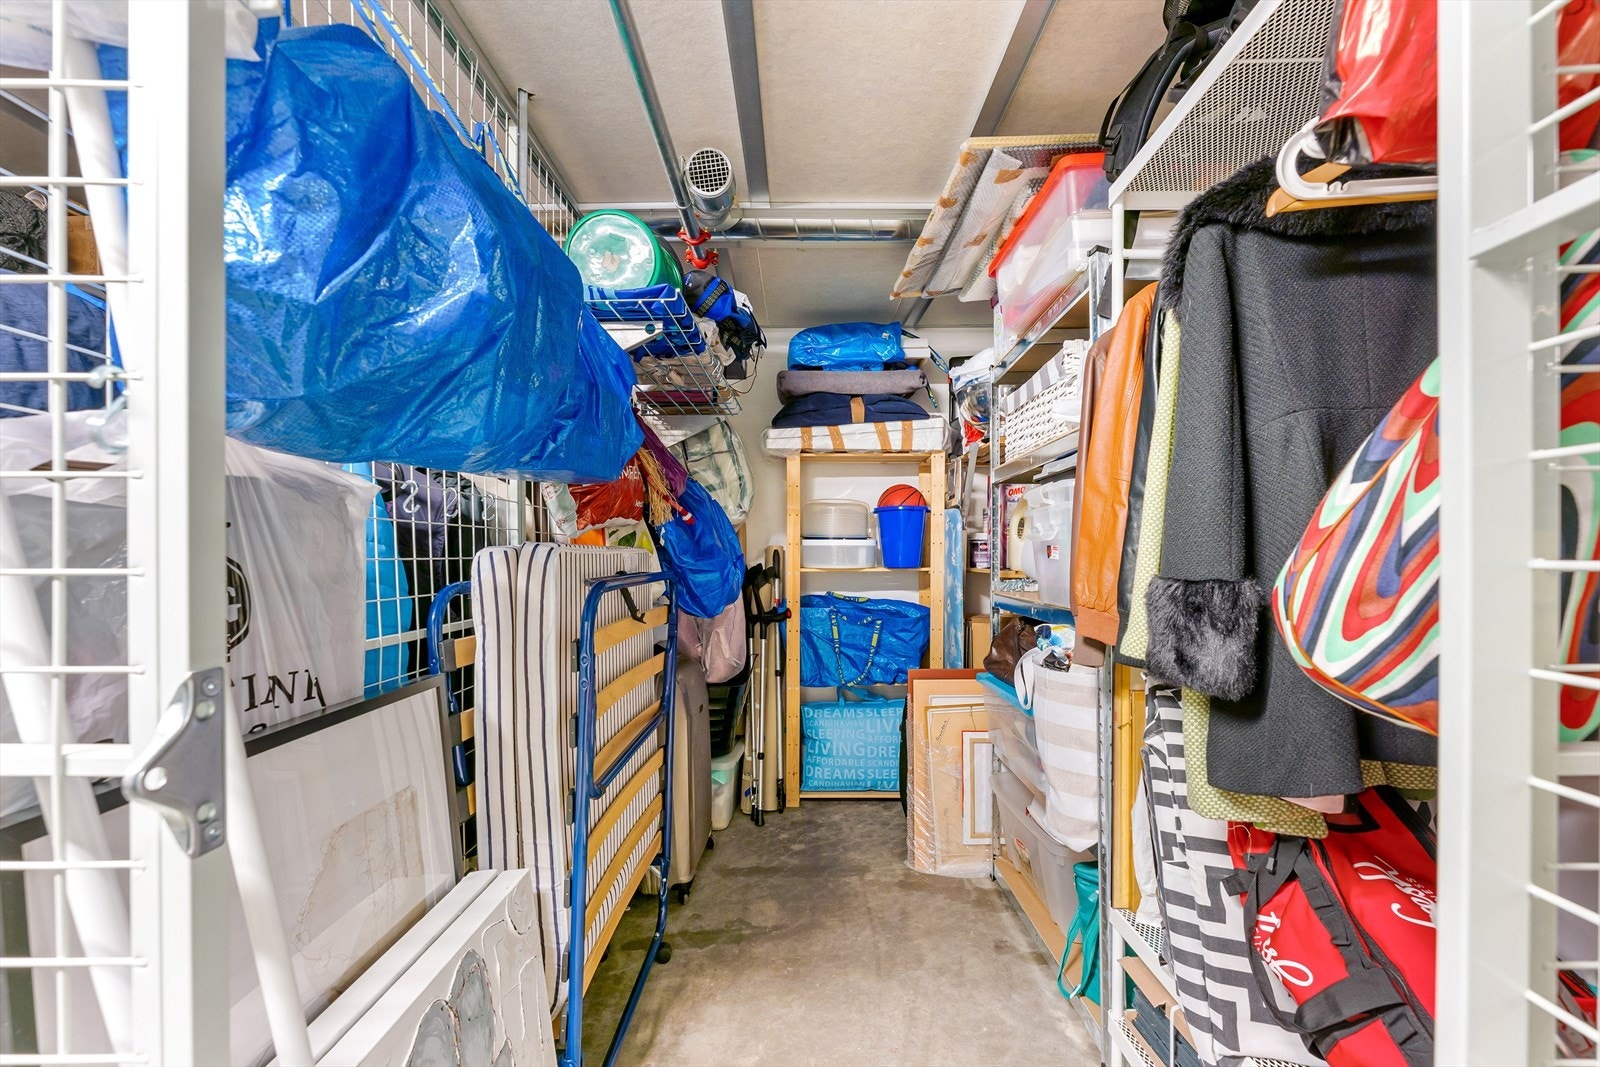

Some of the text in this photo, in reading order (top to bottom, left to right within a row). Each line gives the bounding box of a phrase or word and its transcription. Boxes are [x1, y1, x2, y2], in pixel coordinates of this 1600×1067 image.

[804, 707, 864, 719] DREAMS
[805, 719, 865, 727] SCANDINAVIAN
[806, 729, 865, 740] SLEEPING
[807, 740, 866, 757] LIVING
[806, 755, 866, 767] AFFORDABLE
[805, 765, 865, 780] DREAMS
